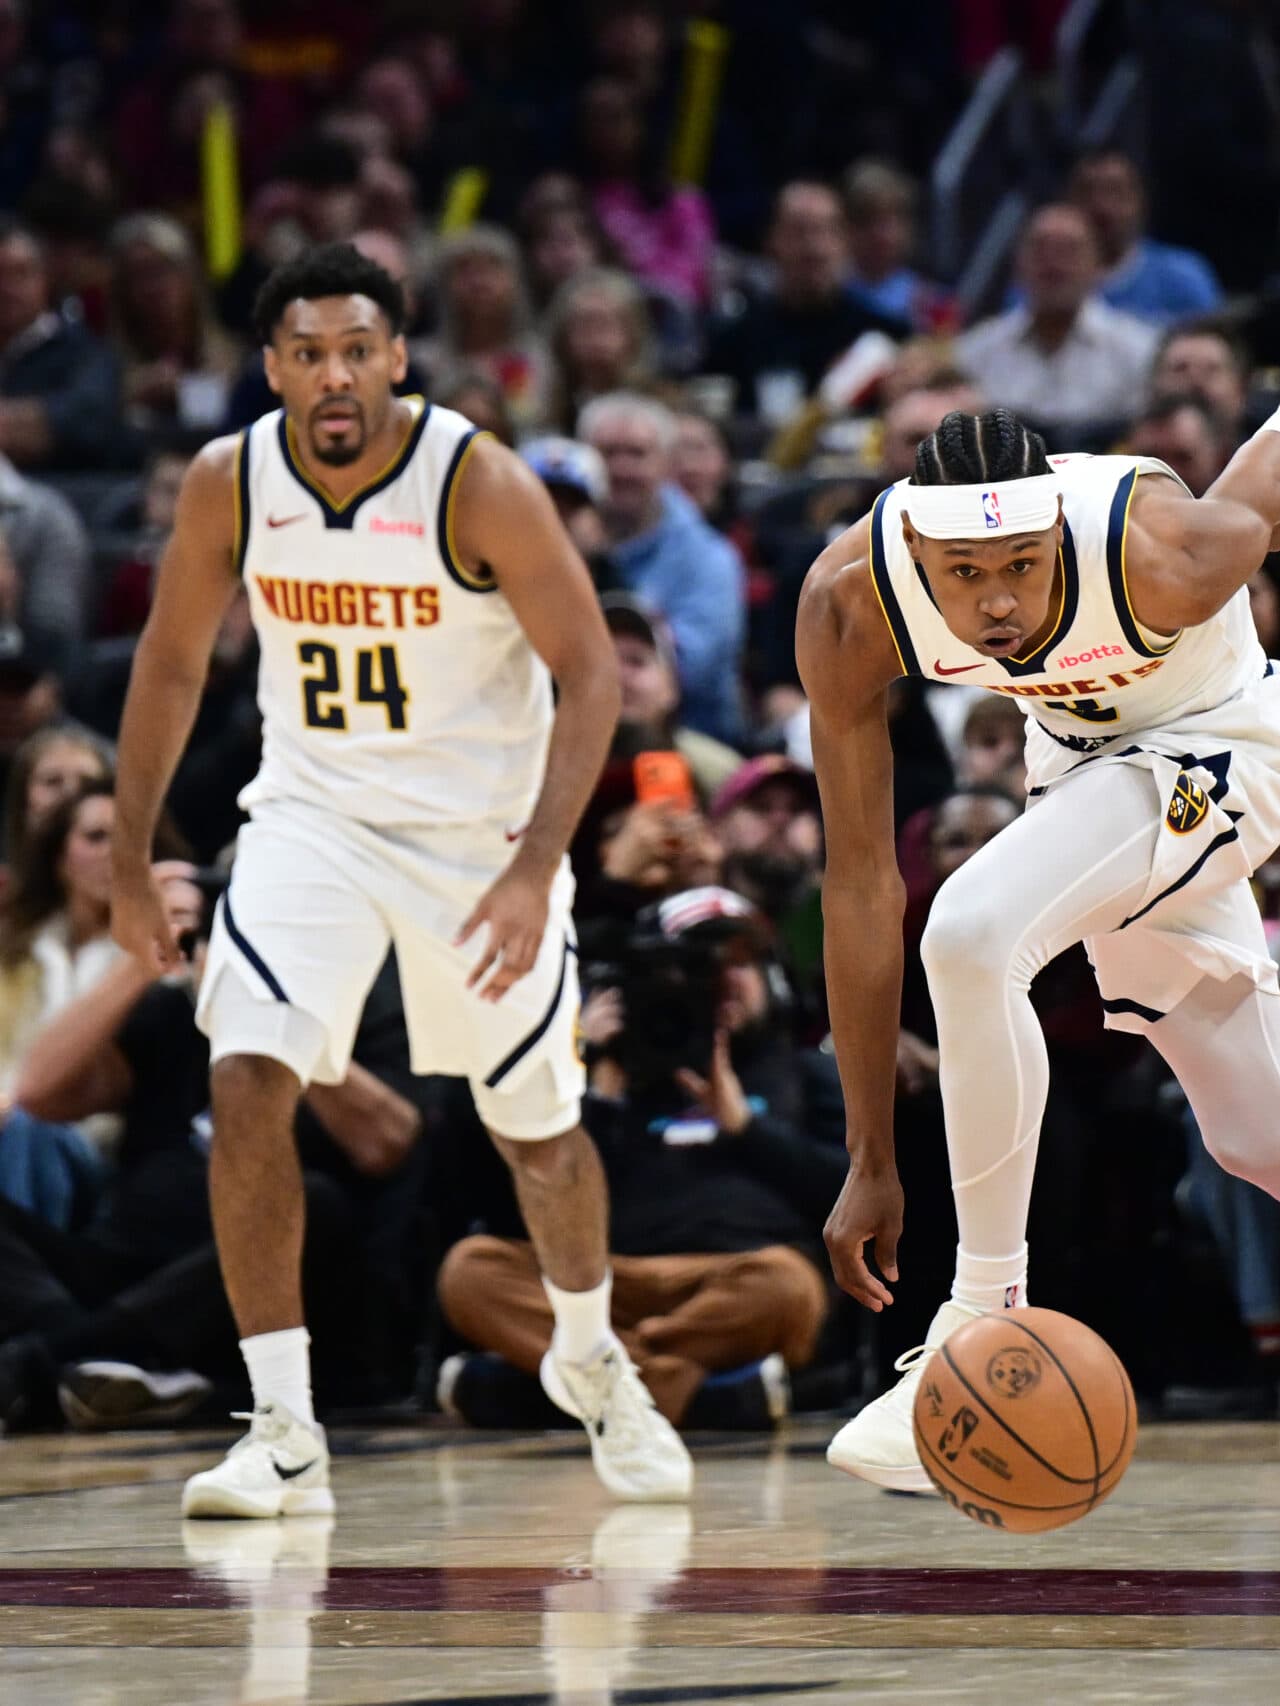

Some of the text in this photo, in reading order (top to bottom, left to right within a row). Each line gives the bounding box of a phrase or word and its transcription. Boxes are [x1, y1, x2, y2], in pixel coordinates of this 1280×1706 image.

[254, 574, 441, 630] NUGGETS
[1056, 644, 1125, 670] ibotta
[297, 637, 411, 734] 24
